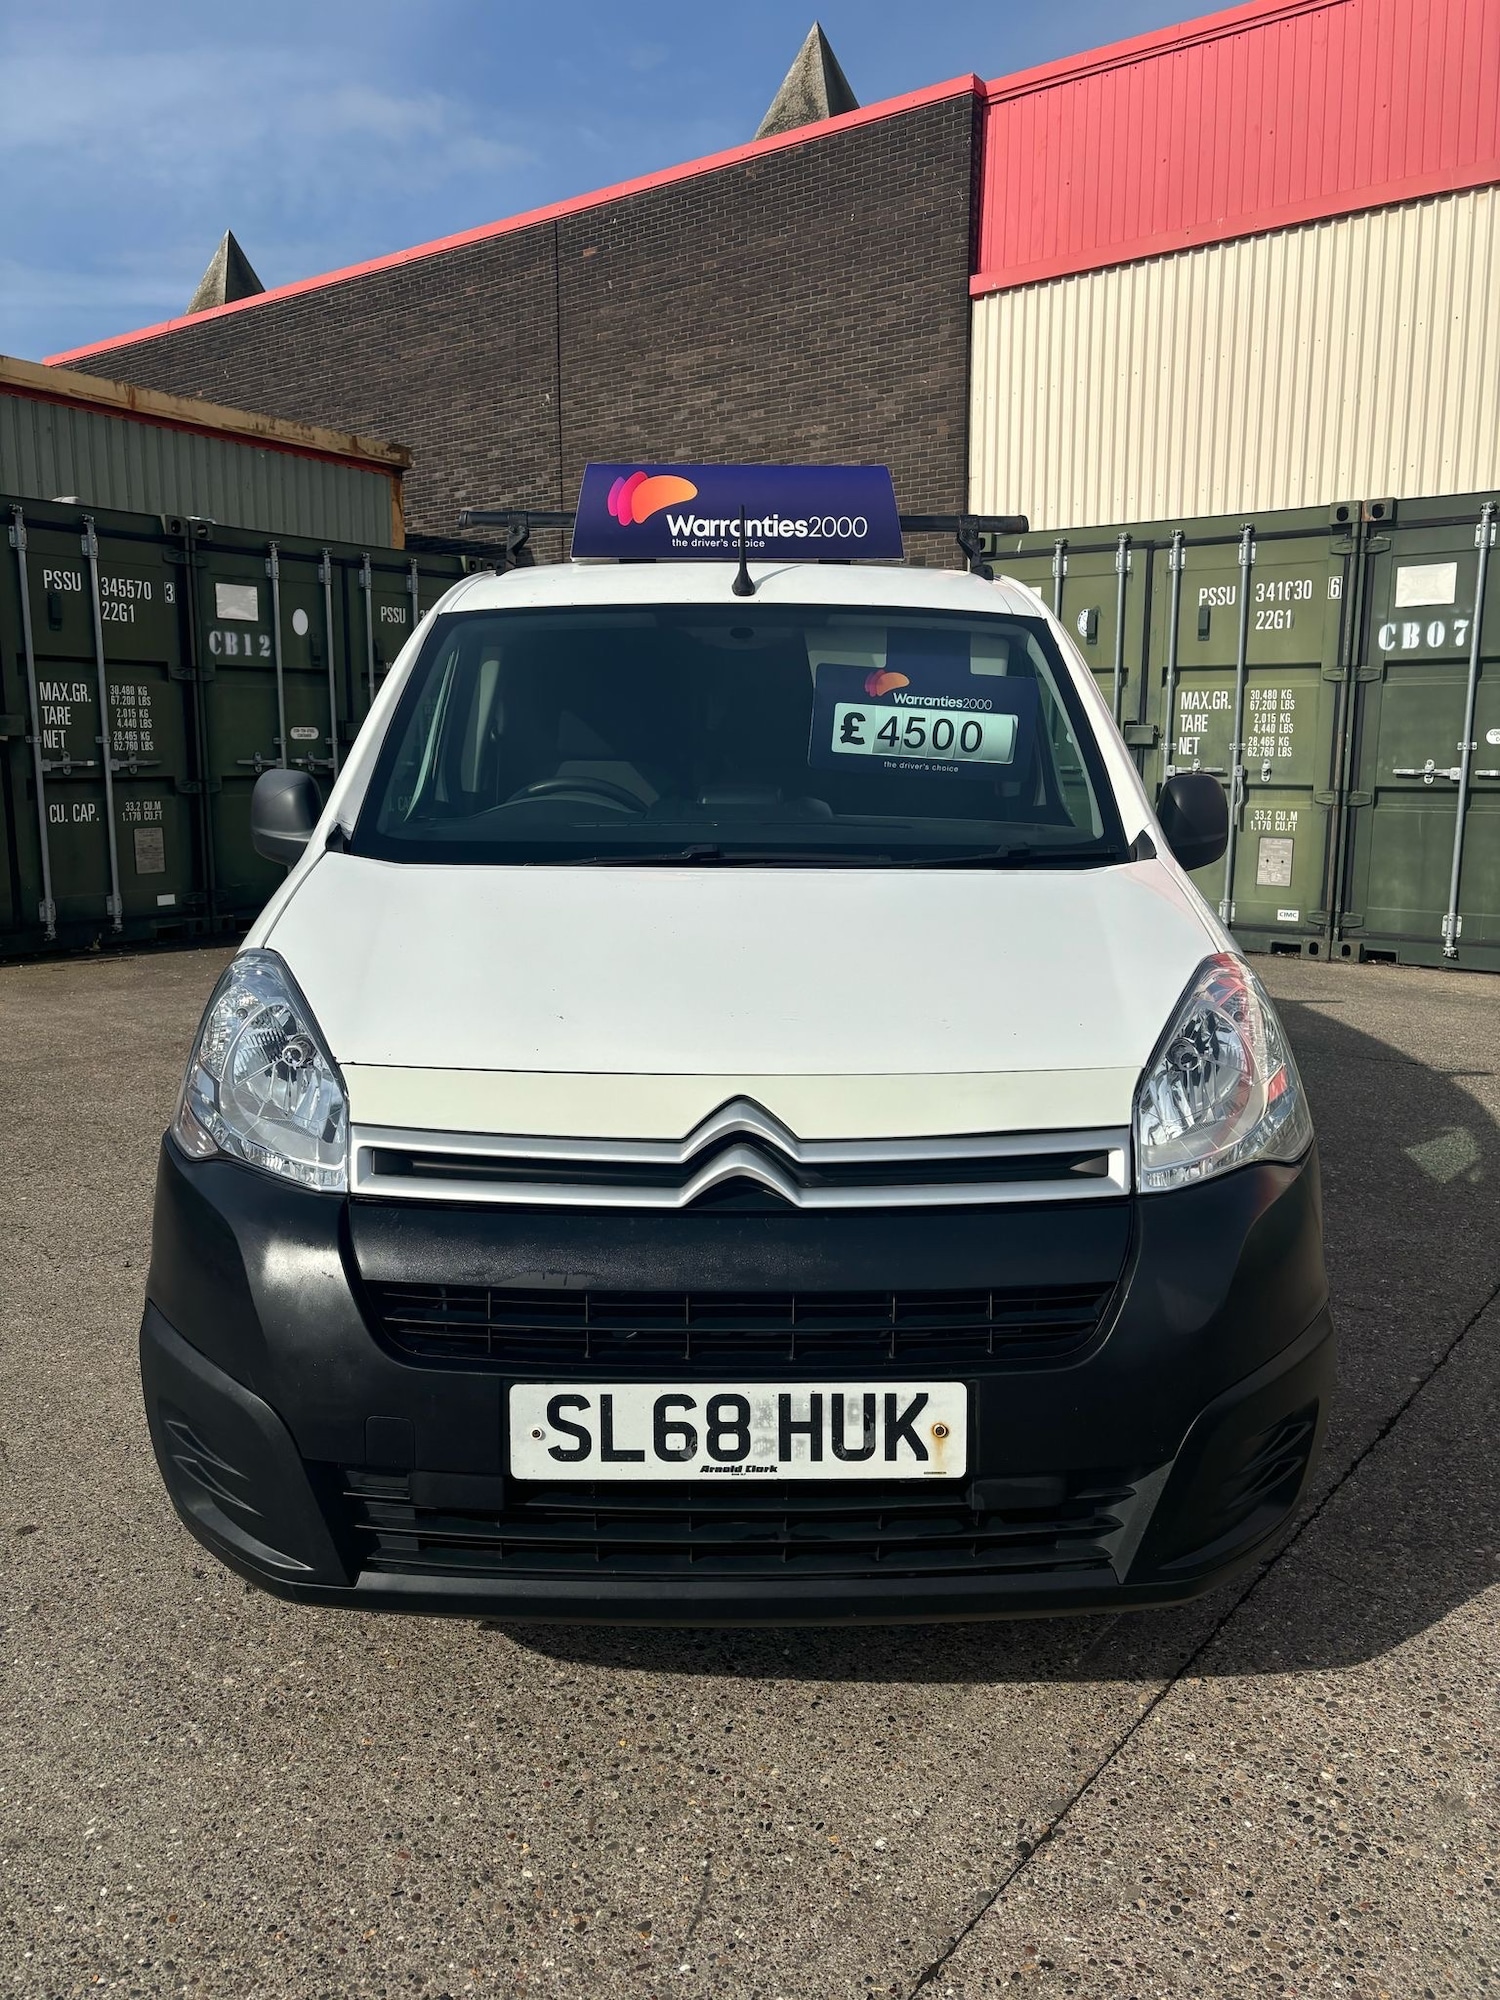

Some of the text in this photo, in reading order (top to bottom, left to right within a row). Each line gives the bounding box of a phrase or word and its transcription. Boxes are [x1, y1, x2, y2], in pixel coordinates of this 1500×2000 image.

[666, 514, 868, 538] Warranties2000
[672, 539, 688, 547] the
[691, 538, 729, 547] driver's
[43, 569, 174, 602] PSSU 345570 3
[1199, 586, 1236, 606] PSSU
[1330, 578, 1340, 597] 6
[101, 601, 135, 623] 22G1
[380, 606, 406, 624] PSSU
[1255, 609, 1292, 630] 22G1
[208, 630, 271, 657] CB12
[39, 681, 92, 703] MAX.GR.
[137, 686, 148, 696] KG
[1281, 689, 1292, 699] KG
[138, 696, 152, 706] LBS
[893, 692, 993, 711] Warranties2000
[1180, 690, 1232, 710] MAX.GR.
[1280, 700, 1295, 710] LBS
[41, 705, 72, 725] TARE
[139, 709, 149, 719] KG
[1280, 713, 1291, 724] KG
[139, 719, 153, 729] LBS
[1180, 714, 1209, 733] TARE
[1279, 723, 1294, 734] LBS
[42, 730, 66, 749] NET
[140, 731, 151, 741] KG
[1278, 736, 1290, 747] KG
[140, 741, 154, 751] LBS
[1178, 737, 1200, 756] NET
[1277, 747, 1293, 757] LBS
[883, 761, 959, 773] the driver's choice
[49, 803, 100, 823] CU. CAP.
[1254, 810, 1298, 821] 33.2 CU.M
[1274, 820, 1297, 831] CU.FT
[546, 1392, 929, 1463] SL68 HUK
[699, 1464, 743, 1474] Arnold
